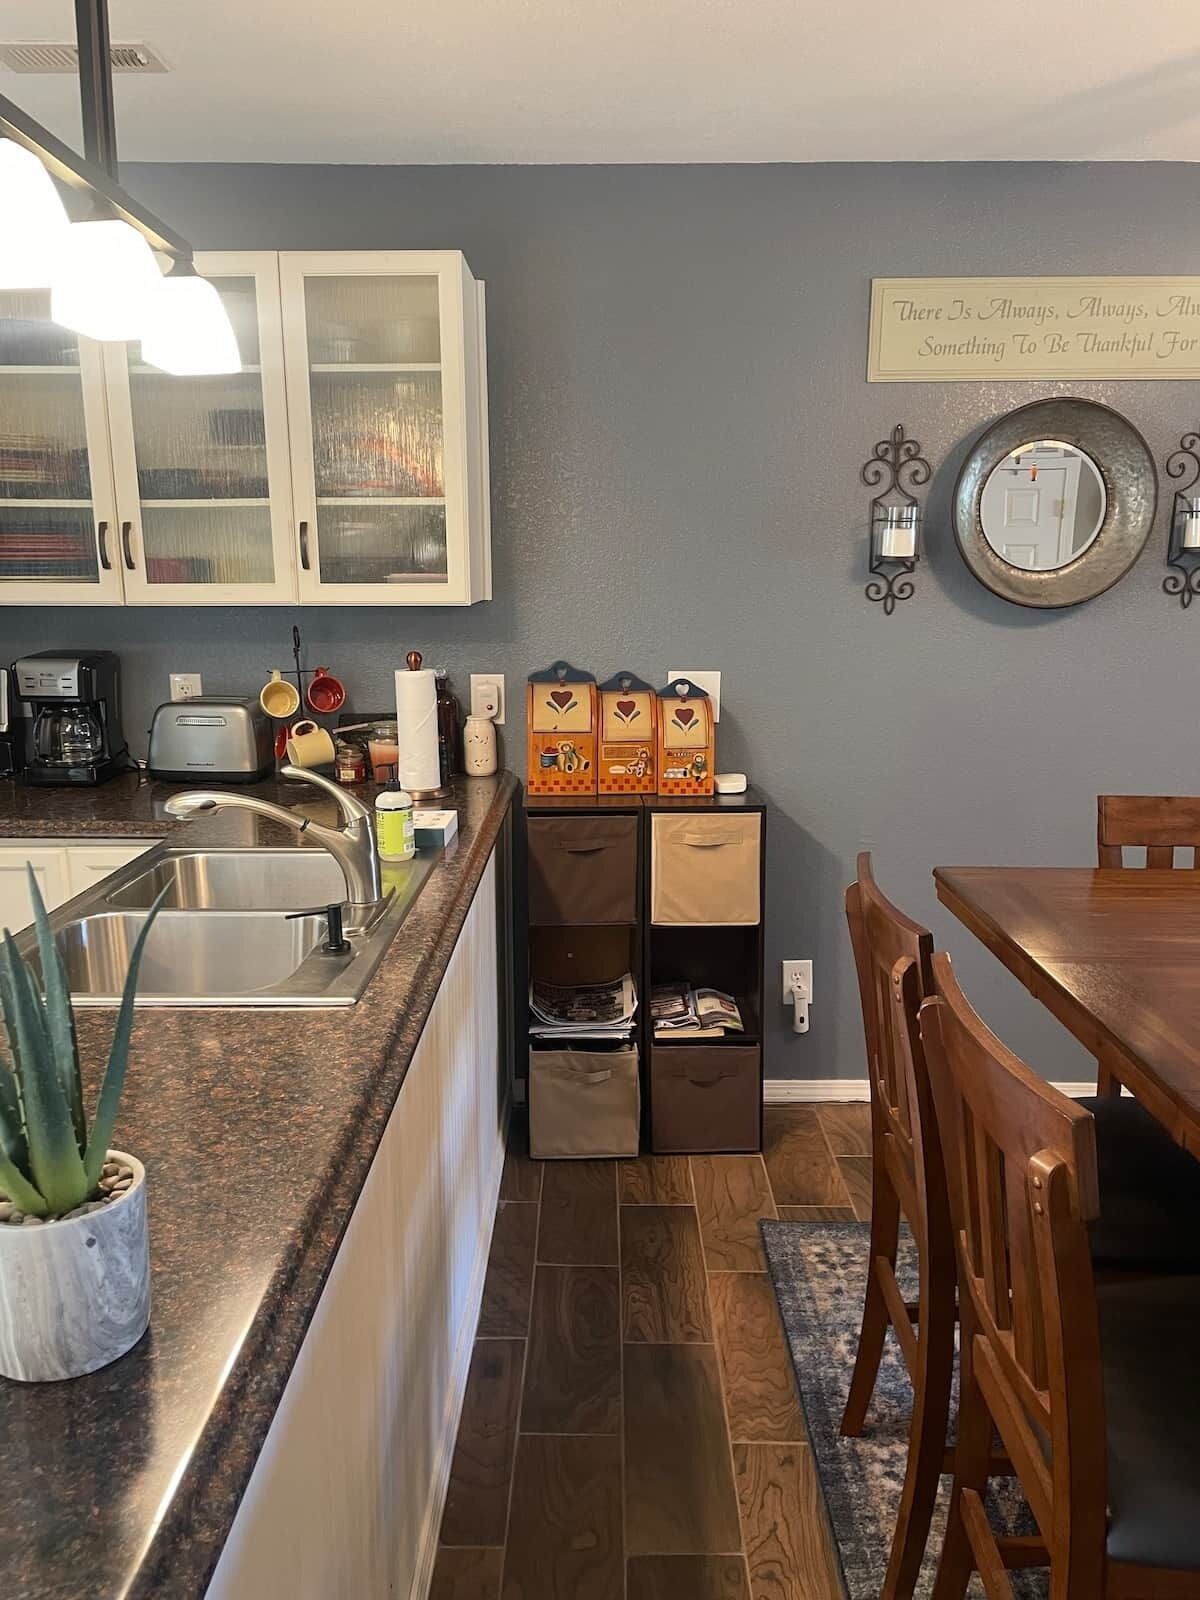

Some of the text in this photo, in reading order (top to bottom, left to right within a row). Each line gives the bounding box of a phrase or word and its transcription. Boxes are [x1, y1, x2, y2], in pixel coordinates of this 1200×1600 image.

[892, 300, 943, 321] There
[946, 299, 973, 320] Is
[977, 298, 1060, 326] Always,
[1066, 296, 1148, 325] Always,
[917, 331, 1199, 362] Something To Be Thankful For
